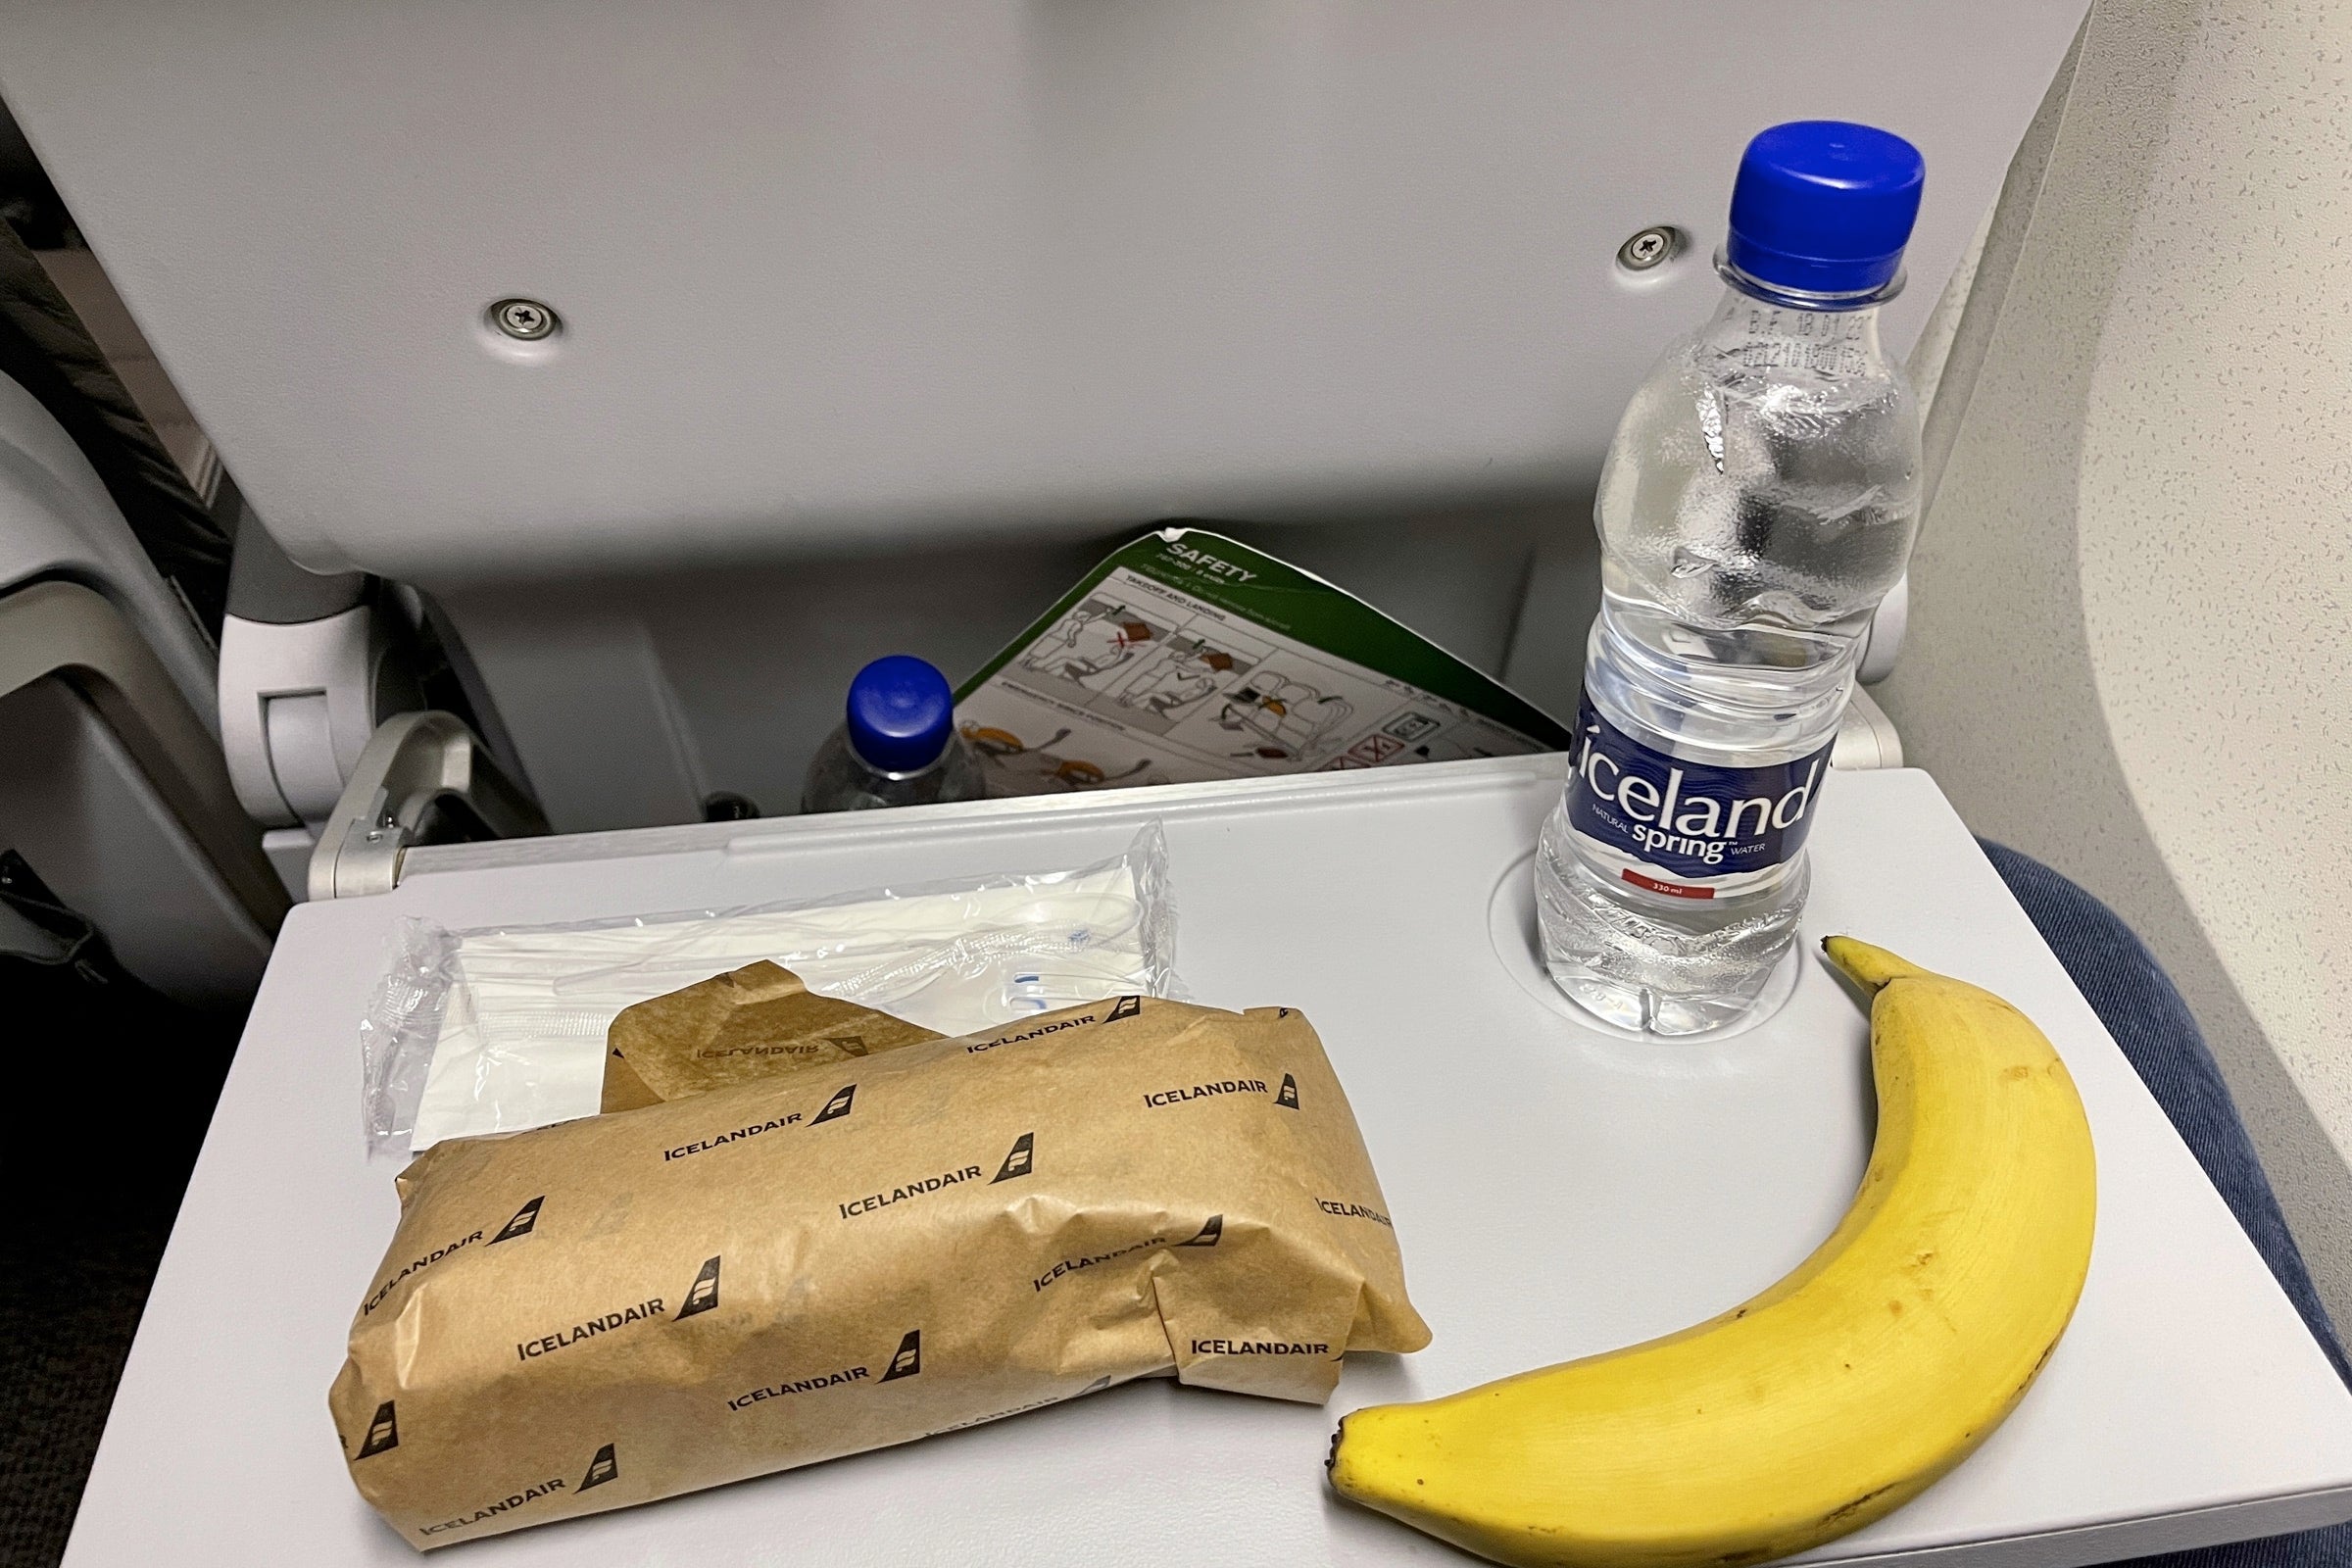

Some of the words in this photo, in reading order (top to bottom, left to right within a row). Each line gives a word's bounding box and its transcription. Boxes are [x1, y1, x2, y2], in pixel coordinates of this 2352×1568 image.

[1166, 543, 1257, 582] SAFETY
[1126, 575, 1167, 596] TAKEOFF
[1166, 592, 1186, 605] AND
[1187, 600, 1226, 622] LANDING
[1592, 804, 1629, 834] NATURAL
[1731, 843, 1766, 856] WATER
[1652, 882, 1670, 892] 330
[966, 1014, 1096, 1054] ICELANDAIR
[1143, 1079, 1268, 1109] ICELANDAIR
[663, 1111, 803, 1162] ICELANDAIR
[838, 1164, 982, 1220] ICELANDAIR
[363, 1229, 484, 1316] ICELANDAIR
[516, 1298, 666, 1361] ICELANDAIR
[1191, 1338, 1330, 1356] ICELANDAIR
[728, 1365, 869, 1412] ICELANDAIR
[419, 1478, 565, 1536] ICELANDAIR
